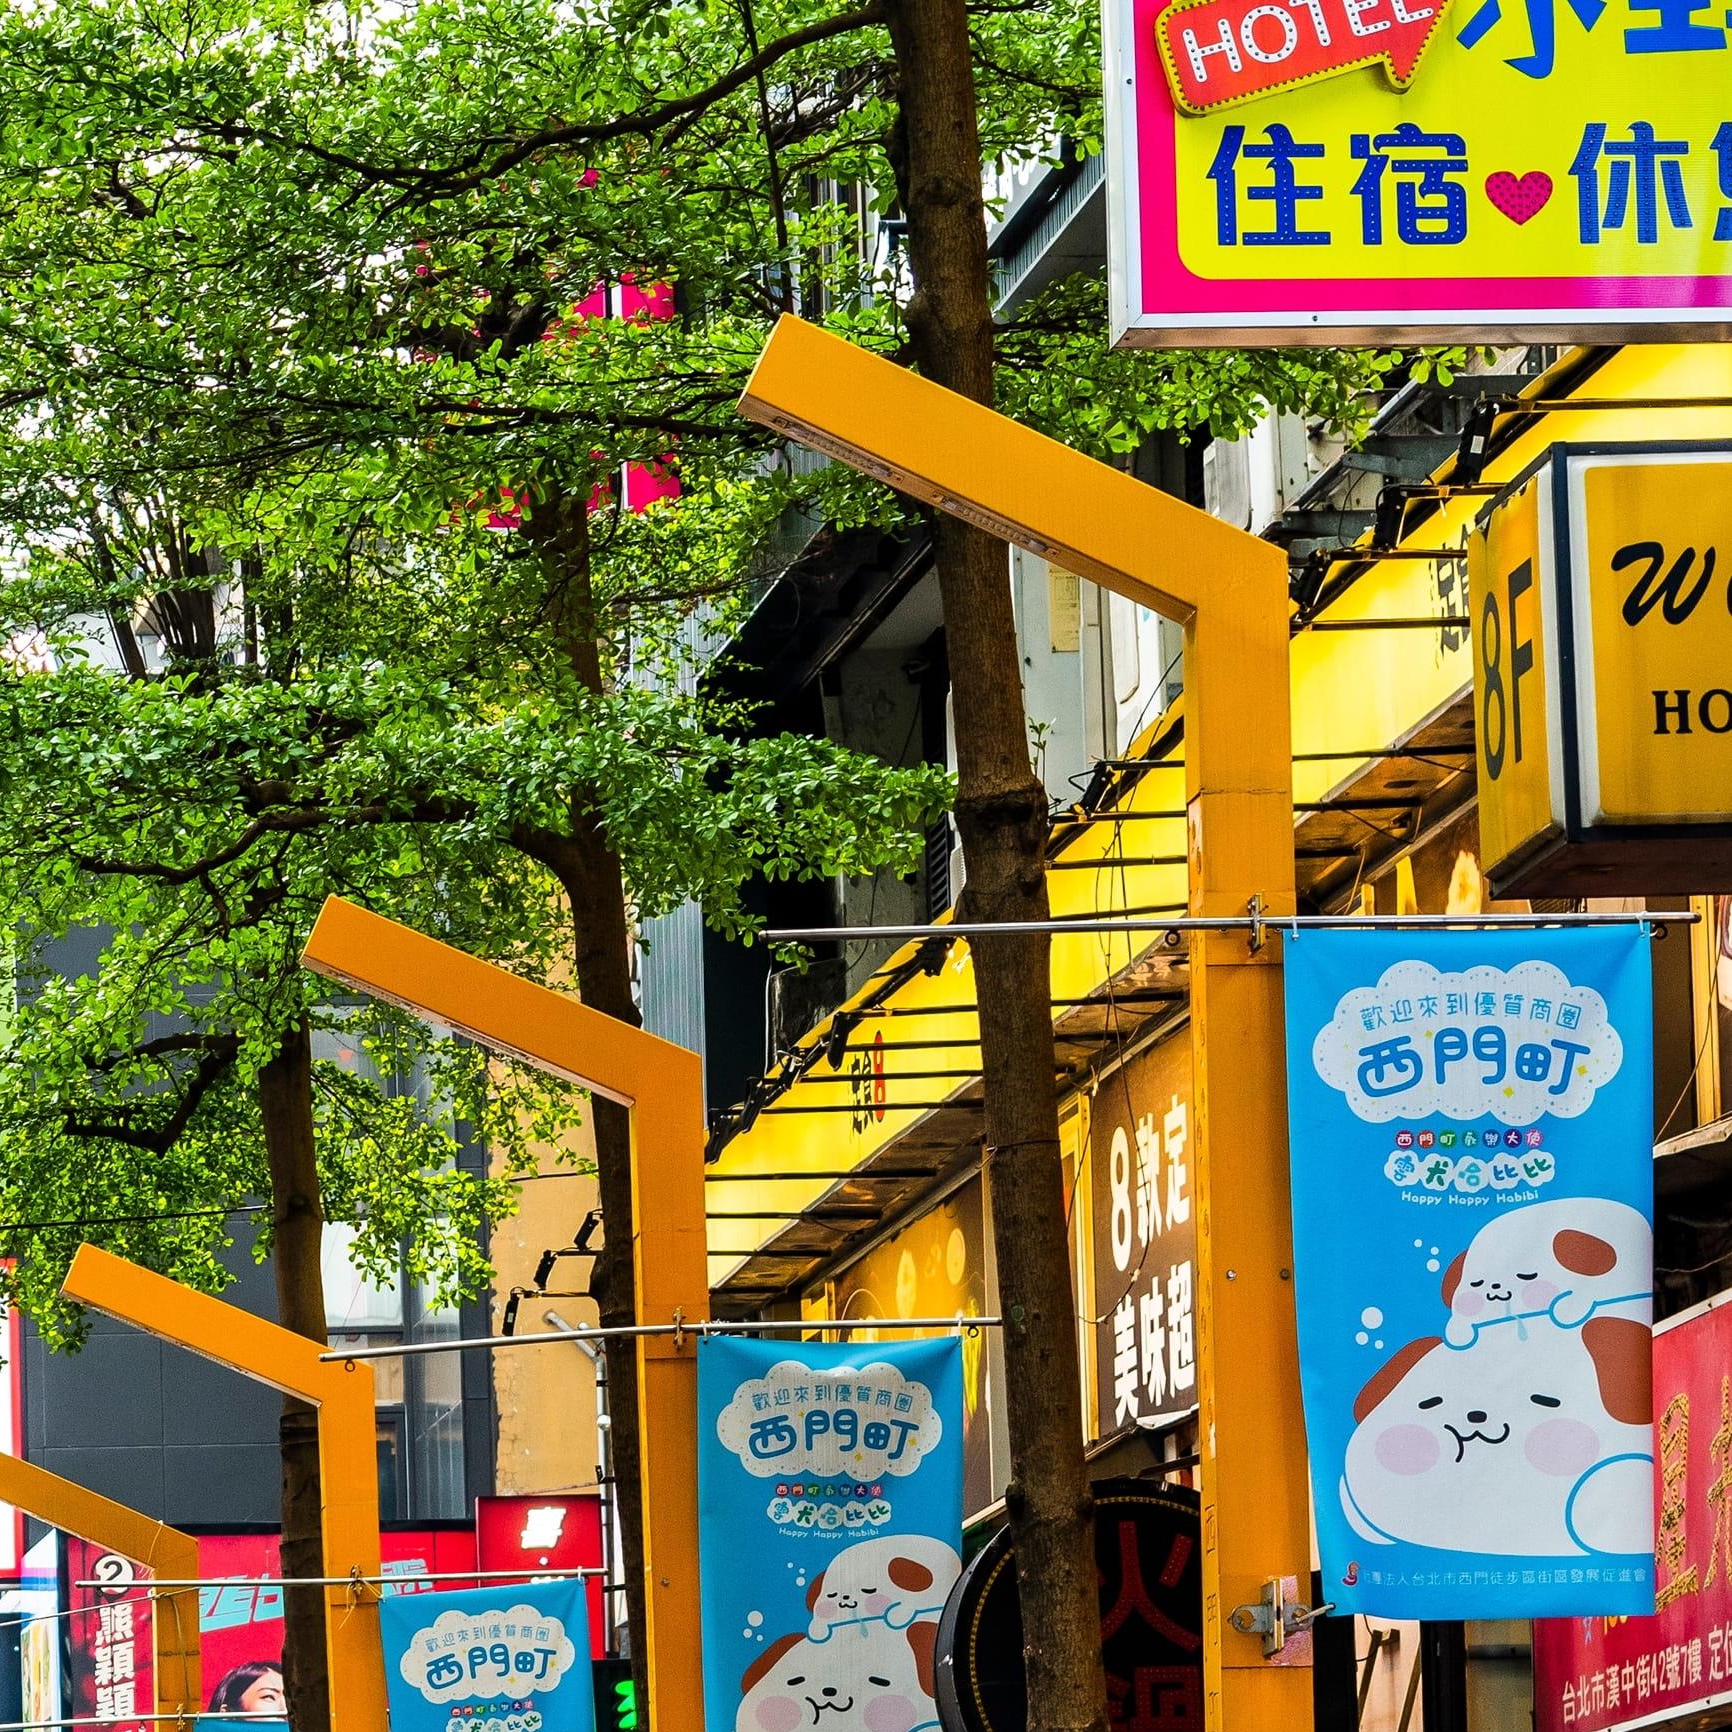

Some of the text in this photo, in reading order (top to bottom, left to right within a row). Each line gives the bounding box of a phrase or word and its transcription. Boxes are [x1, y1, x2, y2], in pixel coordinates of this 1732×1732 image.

[1182, 0, 1434, 83] HOTEL
[1206, 121, 1732, 246] 住宿 休
[1482, 557, 1535, 781] 8F
[1359, 991, 1581, 1031] 歡迎來到優質商圈
[1357, 1025, 1591, 1097] 西門町
[1402, 1190, 1540, 1206] Happy Happy Habibi
[748, 1409, 920, 1460] 西門町
[779, 1528, 807, 1538] Happy
[814, 1529, 842, 1539] Happy
[426, 1642, 557, 1690] 西門町
[1562, 1638, 1702, 1724] 台北市漢中街42號7樓
